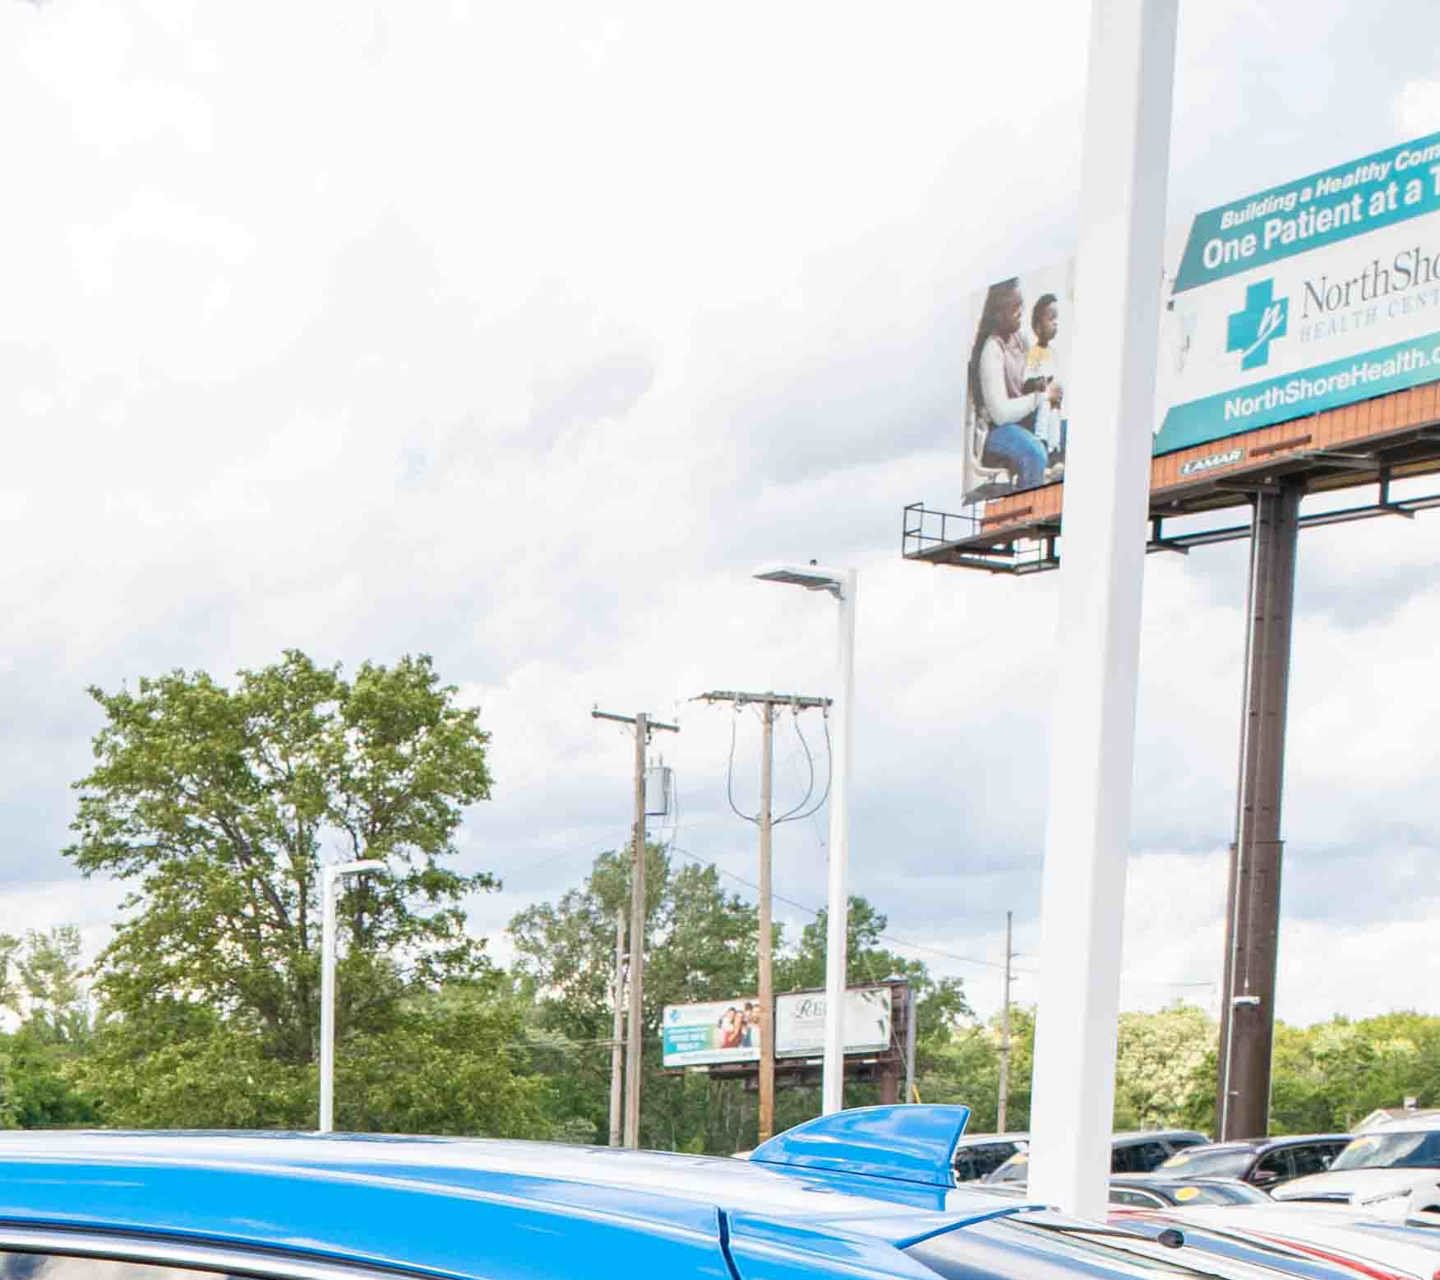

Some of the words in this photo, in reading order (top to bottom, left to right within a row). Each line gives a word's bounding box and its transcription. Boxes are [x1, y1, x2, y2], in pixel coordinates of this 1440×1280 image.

[1203, 232, 1257, 269] One
[1263, 193, 1363, 250] Patient
[1369, 181, 1398, 216] at
[1404, 179, 1422, 205] a
[1221, 191, 1296, 230] Building
[1300, 187, 1312, 203] a
[1316, 161, 1392, 197] Healthy
[1300, 304, 1377, 343] HEALTH
